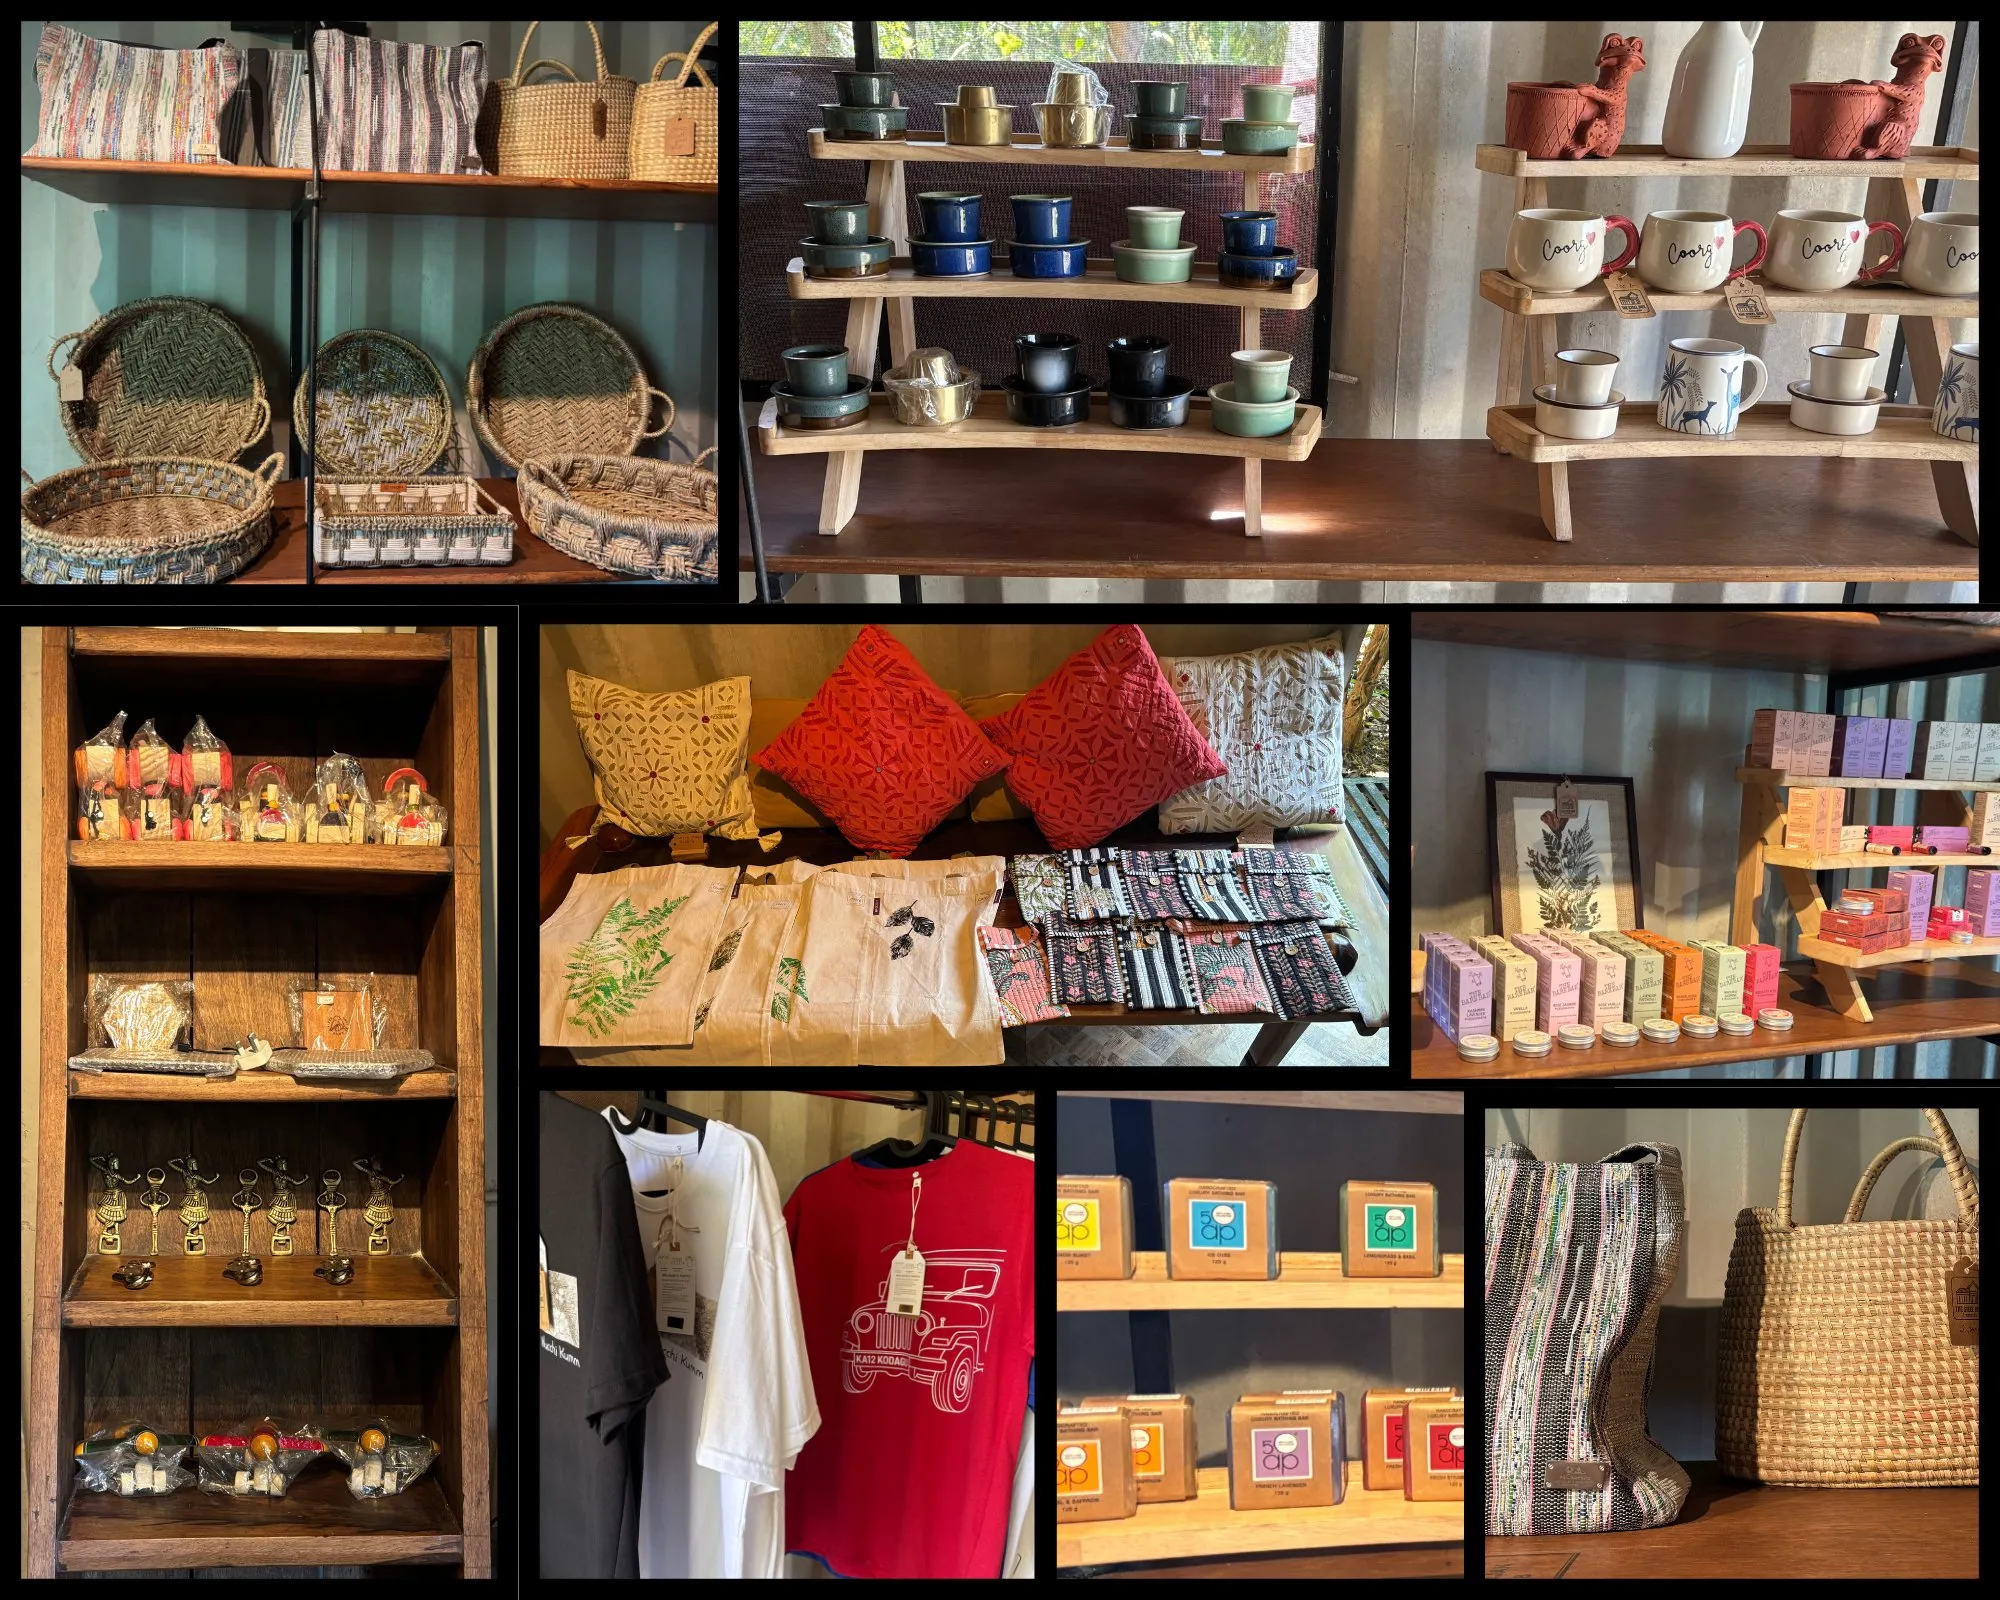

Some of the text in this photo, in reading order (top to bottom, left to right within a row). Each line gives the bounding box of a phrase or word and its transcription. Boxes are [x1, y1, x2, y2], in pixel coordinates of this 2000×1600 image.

[1542, 238, 1587, 264] Coorg
[1667, 242, 1713, 268] Coorg
[1802, 237, 1850, 262] Coorg
[855, 1354, 876, 1364] KA12
